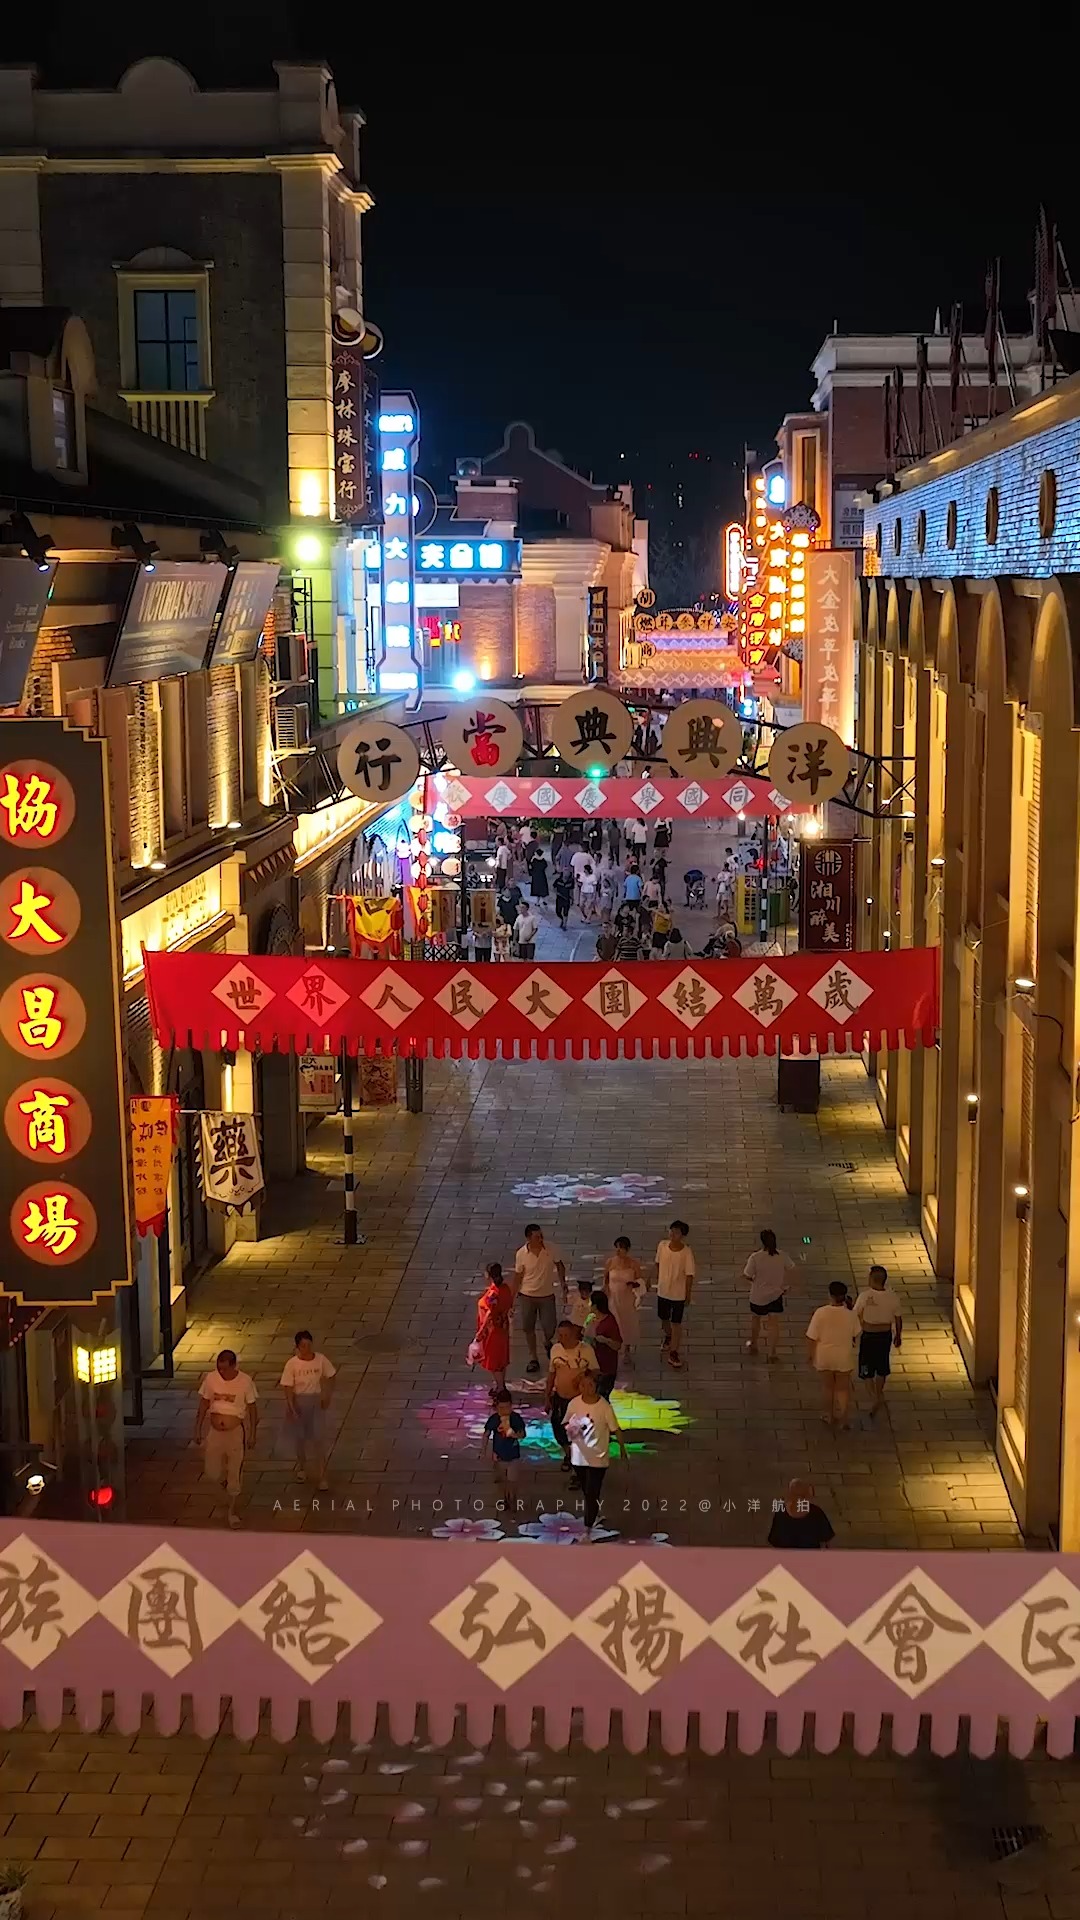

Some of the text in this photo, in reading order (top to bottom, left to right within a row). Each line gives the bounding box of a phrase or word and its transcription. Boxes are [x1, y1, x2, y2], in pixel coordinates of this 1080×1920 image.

[335, 369, 358, 501] 廖林珠宝行
[0, 773, 80, 1256] 協大昌商場
[227, 966, 862, 1021] 世界人民大團結萬歲
[210, 1117, 256, 1187] 藥
